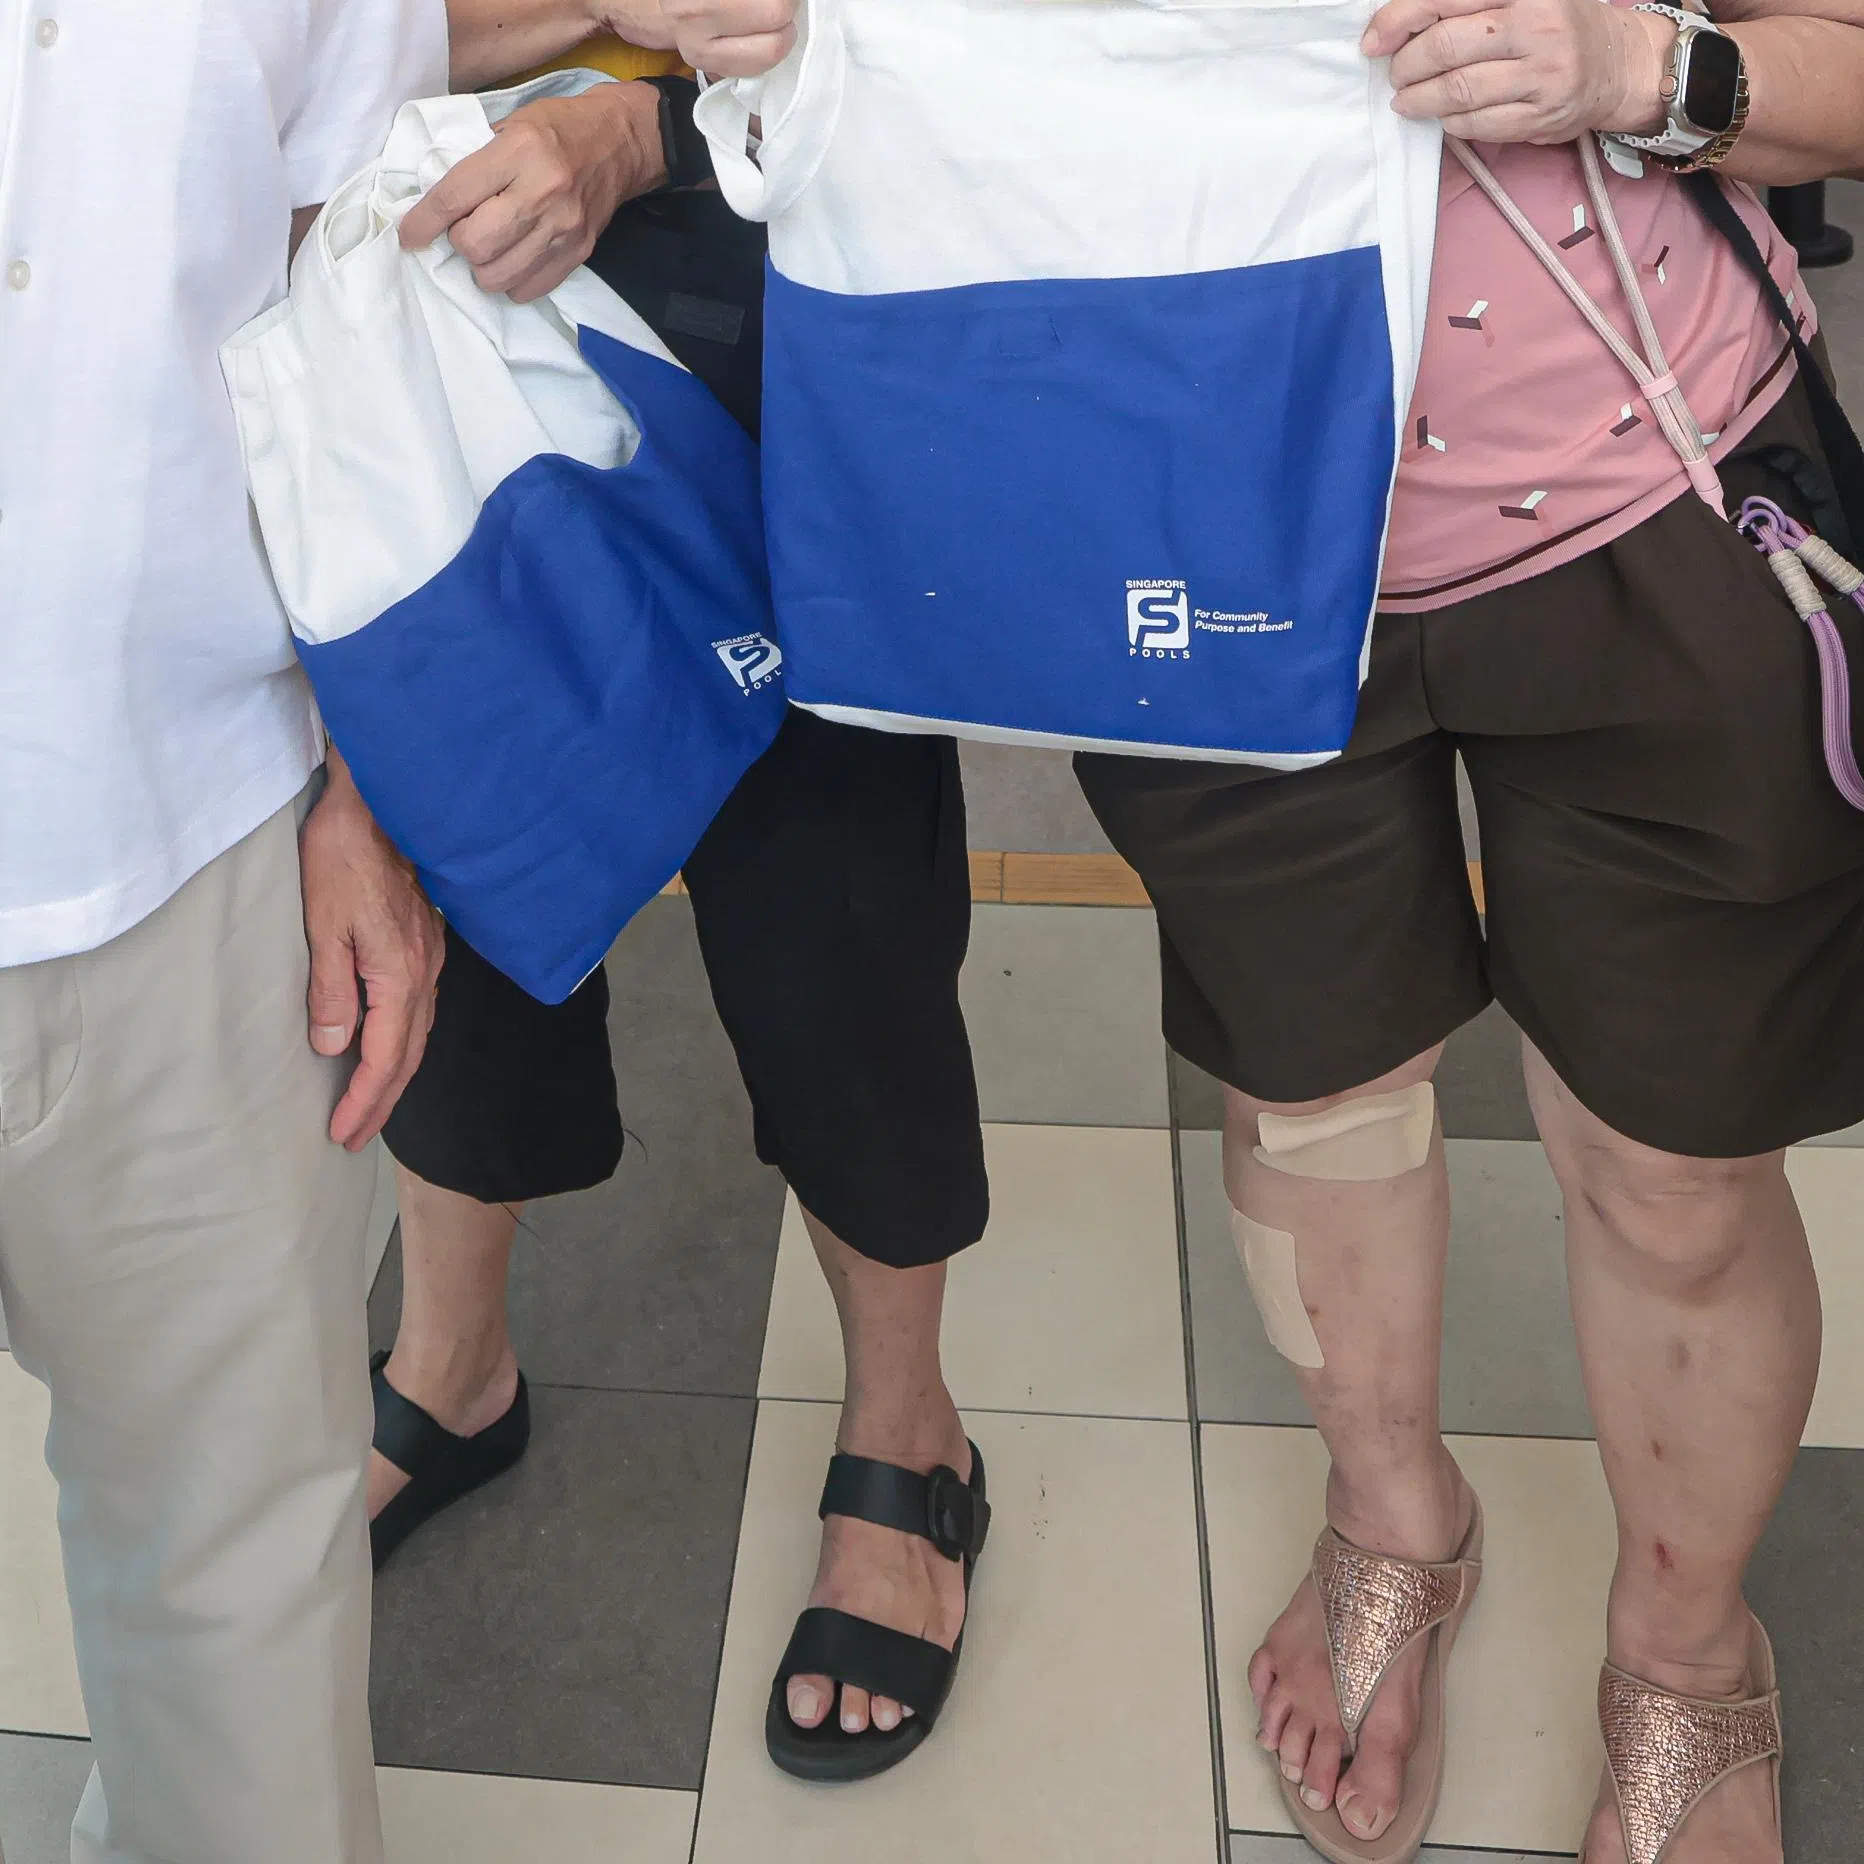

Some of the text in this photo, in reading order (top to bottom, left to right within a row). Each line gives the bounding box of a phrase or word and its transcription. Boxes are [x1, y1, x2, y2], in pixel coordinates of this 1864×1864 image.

[1125, 579, 1187, 590] SINGAPORE
[1194, 608, 1269, 623] For Community
[1194, 619, 1294, 634] Purpose and Benefit
[711, 631, 763, 649] SINGAPORE
[1129, 647, 1191, 660] POOLS
